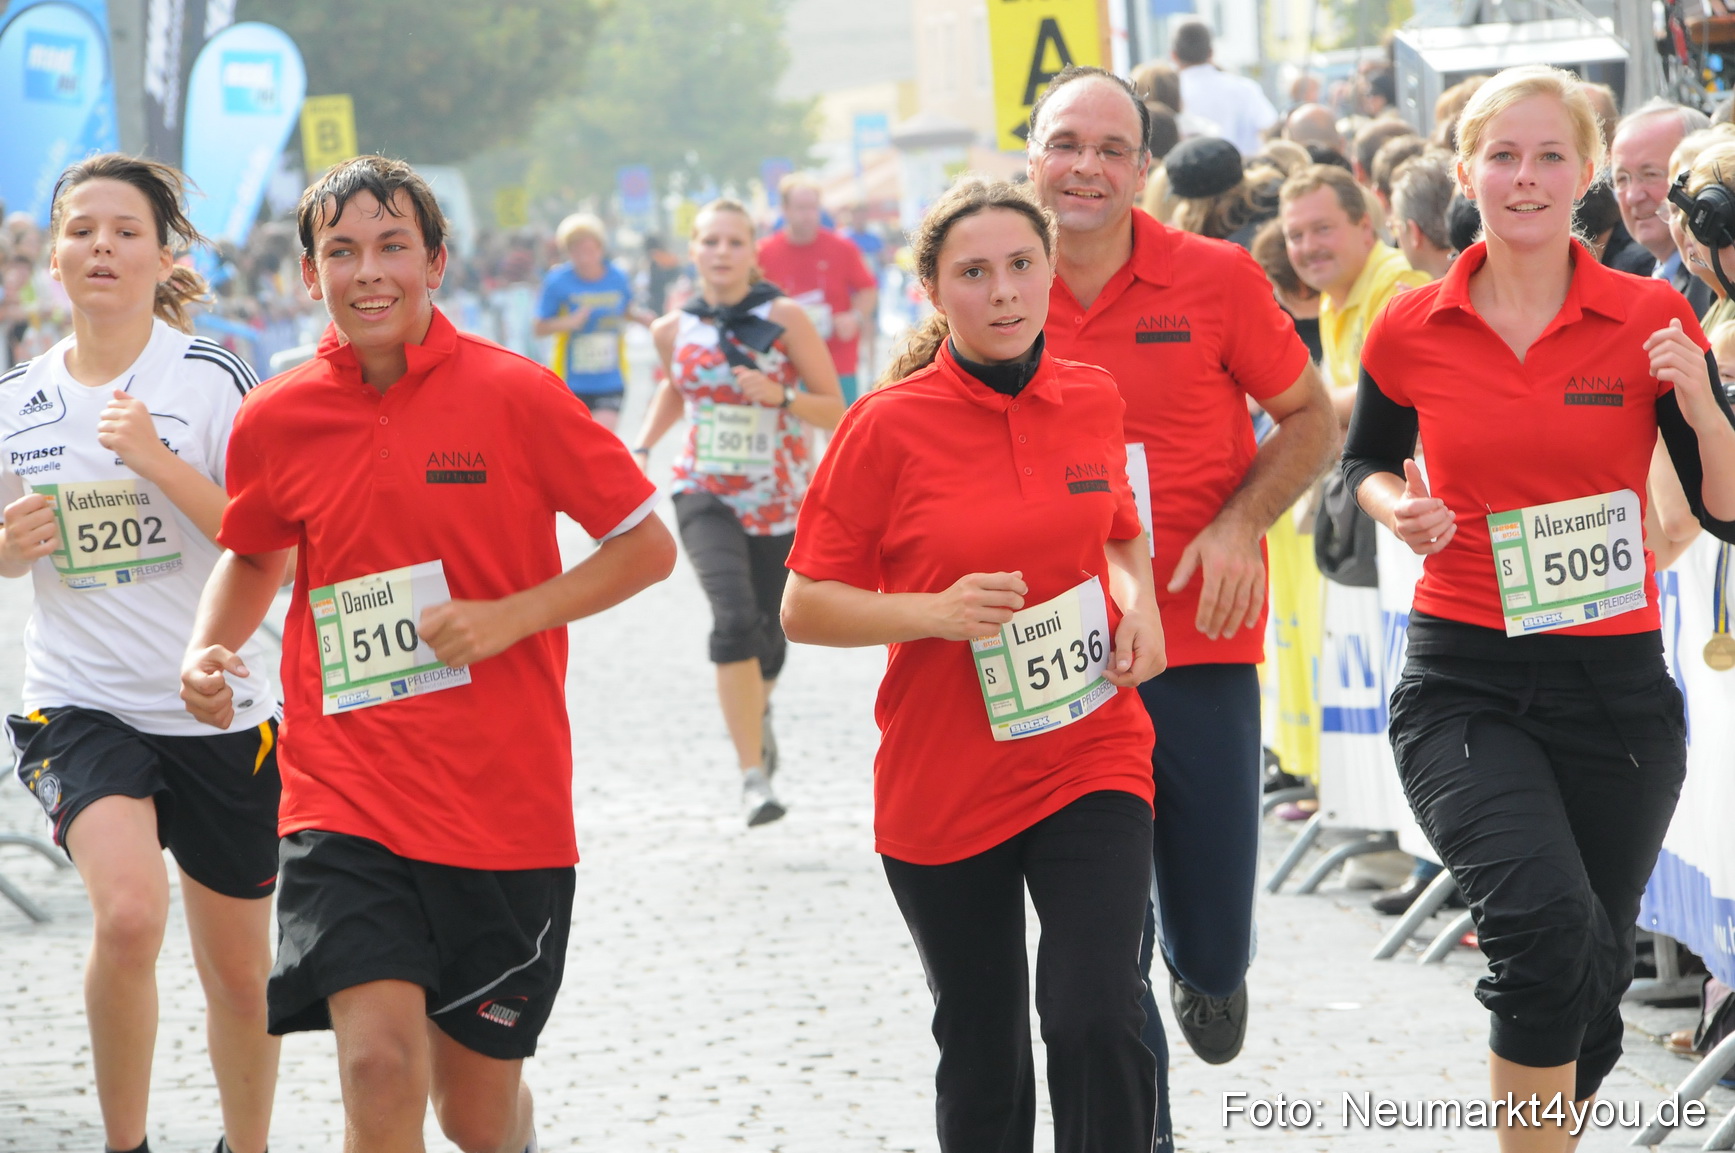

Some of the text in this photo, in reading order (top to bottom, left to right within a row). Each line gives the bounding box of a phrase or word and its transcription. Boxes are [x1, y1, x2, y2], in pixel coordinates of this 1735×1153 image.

[1023, 17, 1075, 106] A
[315, 118, 342, 153] B
[1136, 314, 1190, 329] ANNA
[1565, 376, 1624, 392] ANNA
[19, 401, 53, 416] adidas
[718, 431, 768, 454] 5018
[11, 444, 66, 466] Pyraser
[426, 451, 486, 467] ANNA
[1065, 463, 1108, 481] ANNA
[65, 489, 150, 511] Katharina
[1534, 503, 1626, 539] Alexandra
[78, 516, 166, 553] 5202
[131, 558, 183, 577] PFLEIDERER
[1502, 559, 1513, 576] S
[1544, 538, 1632, 586] 5096
[342, 581, 394, 615] Daniel
[1599, 589, 1642, 610] PFLEIDERER
[1011, 610, 1062, 646] Leoni
[323, 635, 331, 653] S
[353, 618, 419, 663] 510
[1027, 629, 1103, 690] 5136
[407, 666, 466, 687] PFLEIDERER
[985, 667, 997, 685] S
[1010, 715, 1050, 734] BOCK
